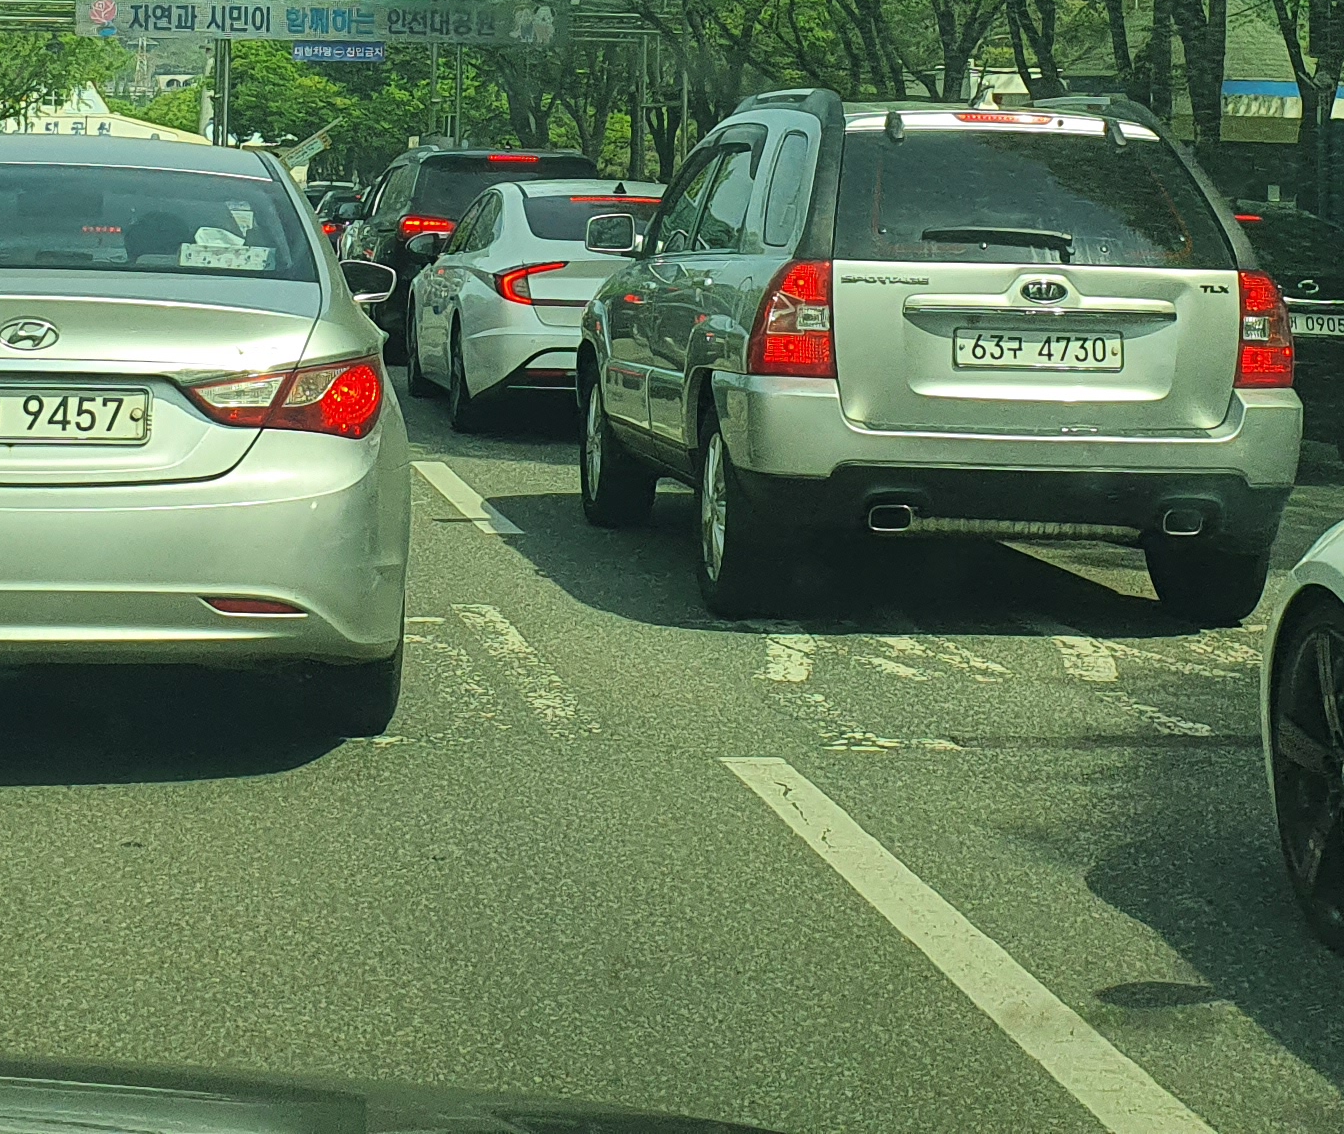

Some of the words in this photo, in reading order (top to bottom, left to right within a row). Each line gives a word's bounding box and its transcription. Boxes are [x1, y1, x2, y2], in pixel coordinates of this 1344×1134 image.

[129, 4, 197, 31] 자연과
[207, 5, 271, 33] 시민이
[286, 7, 375, 34] 함께하는
[1028, 284, 1058, 298] KIA
[1200, 284, 1230, 294] TLX
[971, 334, 1023, 360] 63구
[1037, 335, 1107, 363] 4730
[22, 394, 125, 432] 9457
